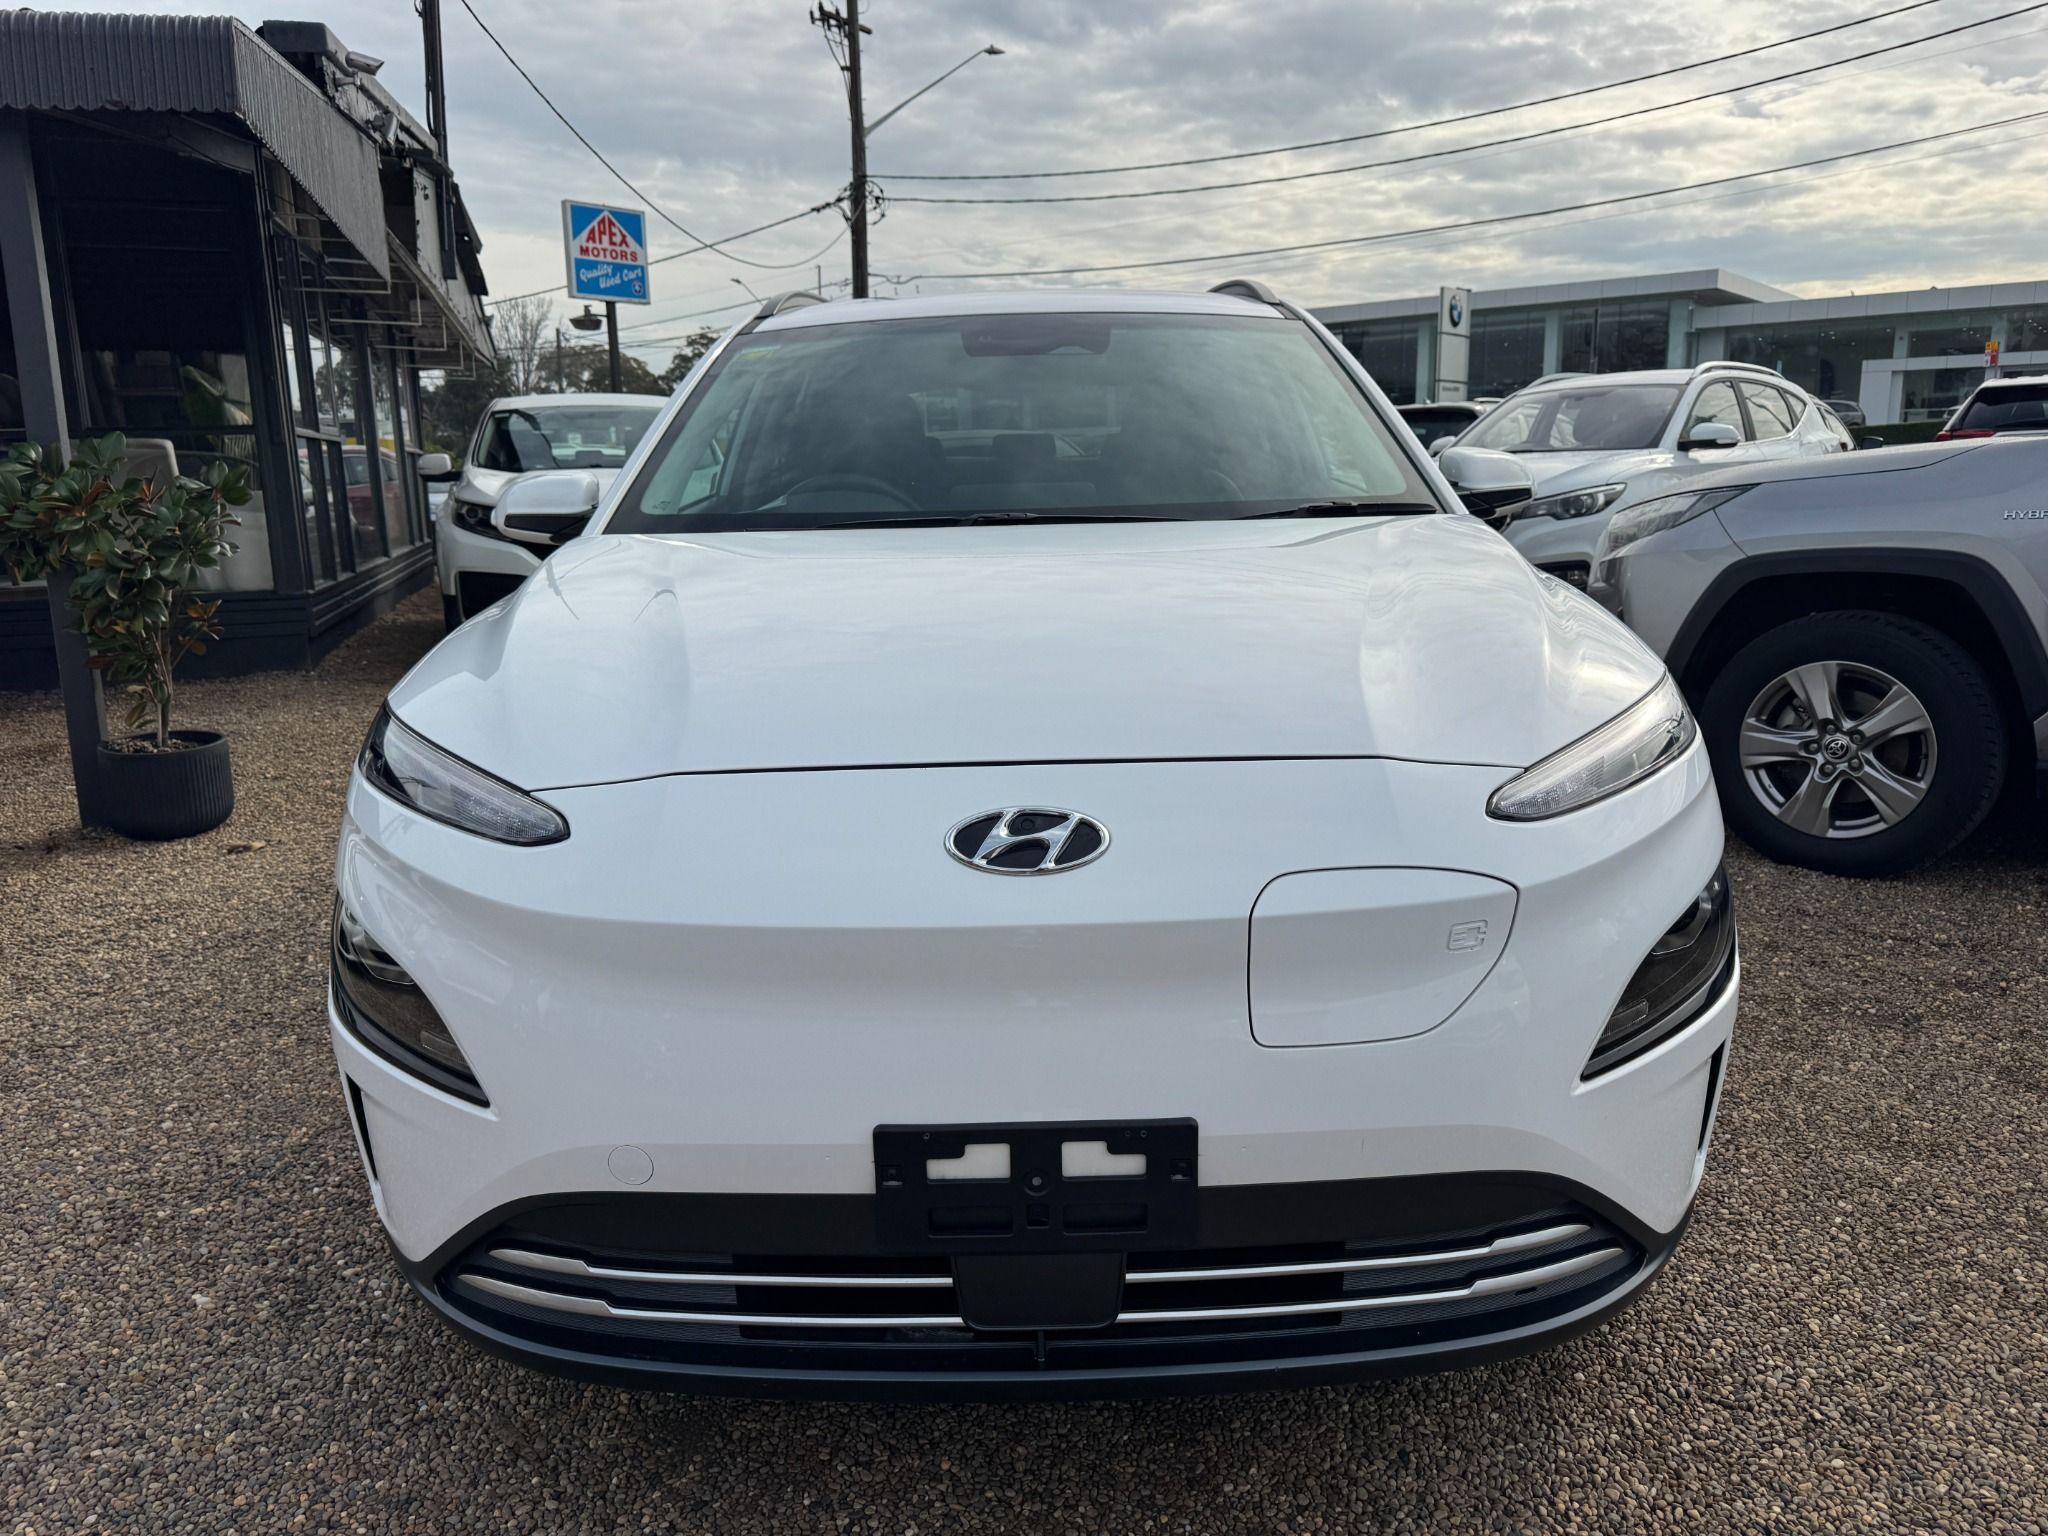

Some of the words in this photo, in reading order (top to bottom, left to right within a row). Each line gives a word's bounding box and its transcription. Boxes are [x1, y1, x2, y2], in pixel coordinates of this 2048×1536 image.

[586, 214, 629, 248] APEX
[579, 245, 638, 262] MOTORS
[579, 264, 613, 282] Quality
[599, 273, 621, 288] Used
[622, 267, 642, 281] Cars
